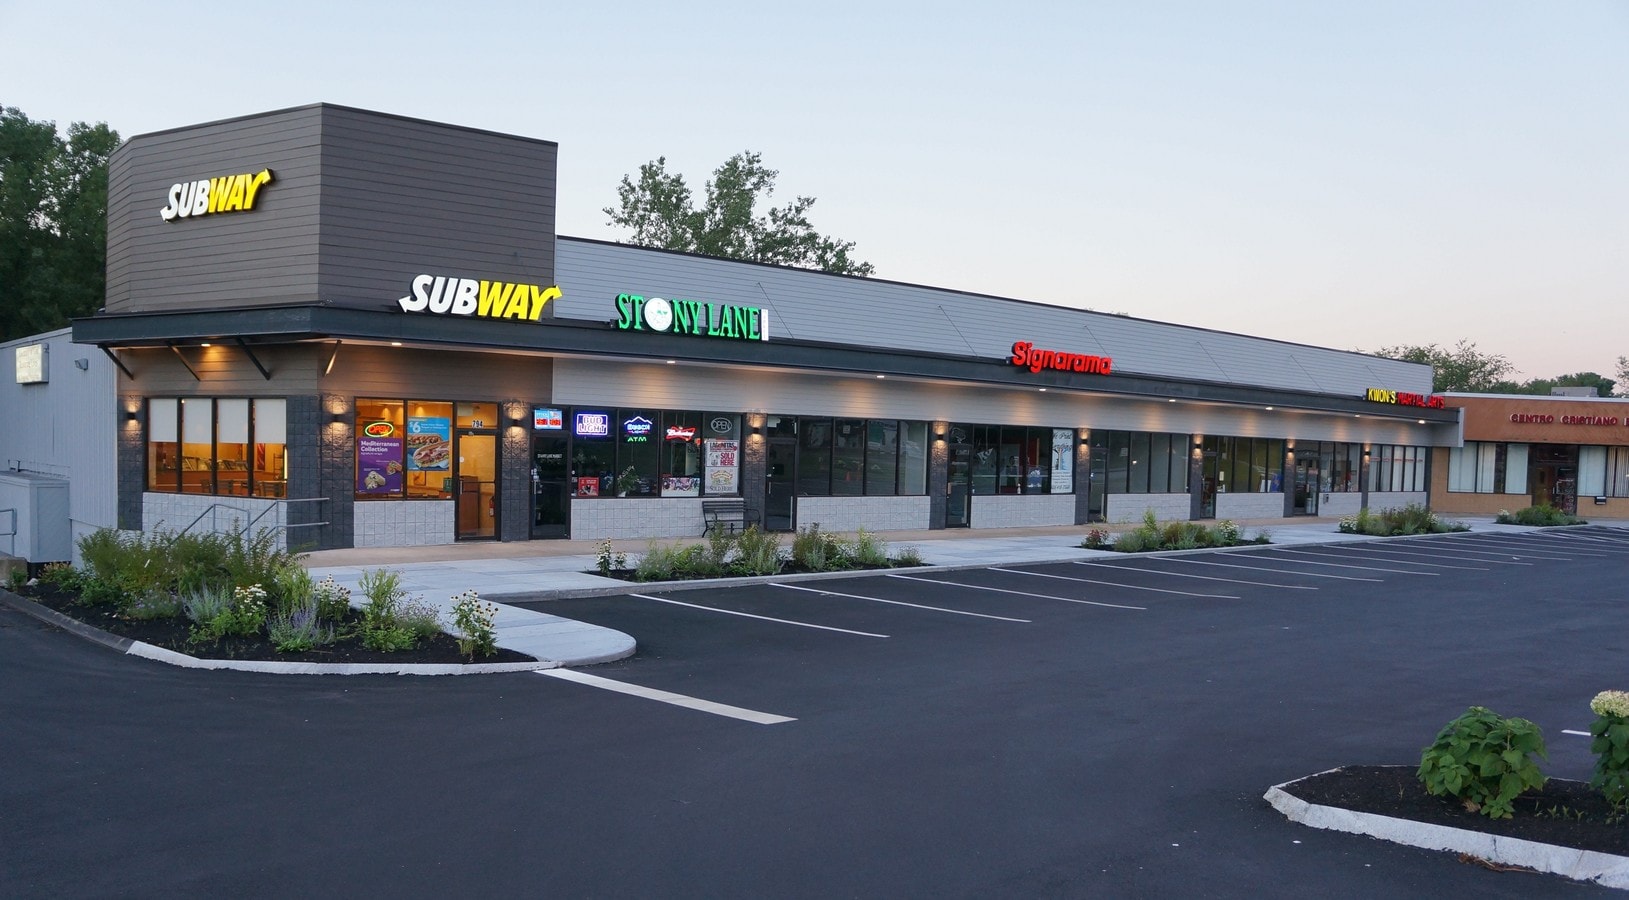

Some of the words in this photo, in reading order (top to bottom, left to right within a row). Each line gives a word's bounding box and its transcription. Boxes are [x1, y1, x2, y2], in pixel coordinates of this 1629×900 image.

[160, 168, 273, 221] SUBWAY
[398, 274, 563, 321] SUBWAY
[704, 303, 761, 340] LANE
[1011, 341, 1112, 375] Signarama
[1367, 388, 1396, 404] KWON'S
[1397, 391, 1427, 408] MARTIAL
[1427, 395, 1445, 409] ARTS
[472, 420, 483, 428] 794
[582, 415, 603, 425] BUD
[711, 420, 731, 430] OPEN
[1510, 413, 1554, 424] CENTRO
[1560, 415, 1618, 426] CRISTIANO
[368, 425, 391, 434] OPEN
[578, 424, 608, 433] LIGHT
[720, 452, 734, 460] SOLD
